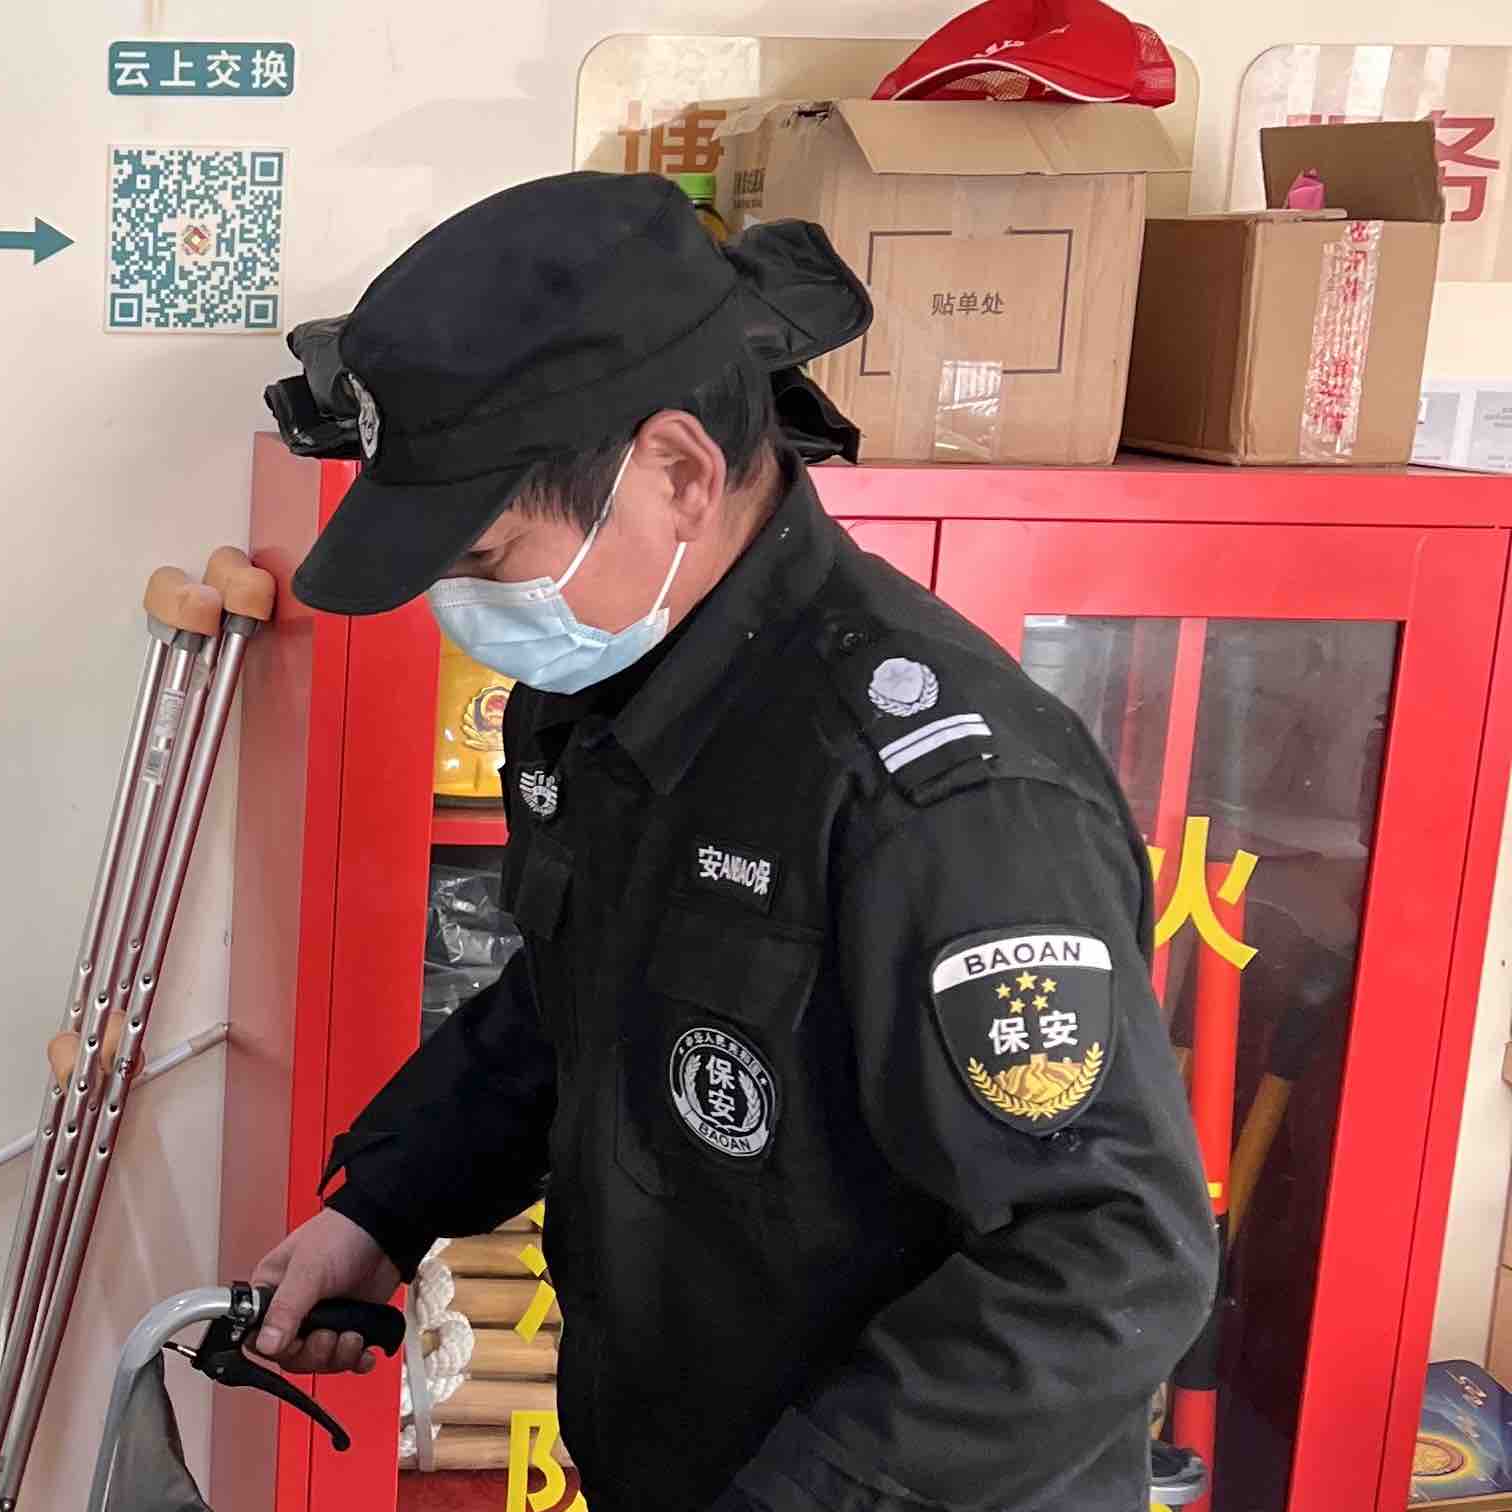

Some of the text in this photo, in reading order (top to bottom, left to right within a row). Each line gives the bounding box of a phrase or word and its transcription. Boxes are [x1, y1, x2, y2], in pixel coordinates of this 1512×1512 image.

[114, 49, 288, 89] 云上交换
[930, 291, 1005, 318] 贴单处
[1148, 816, 1259, 970] 火
[963, 941, 1082, 976] BAOAN
[988, 1010, 1079, 1055] 保安
[705, 1054, 736, 1122] 保安
[698, 1122, 752, 1152] BAOAN
